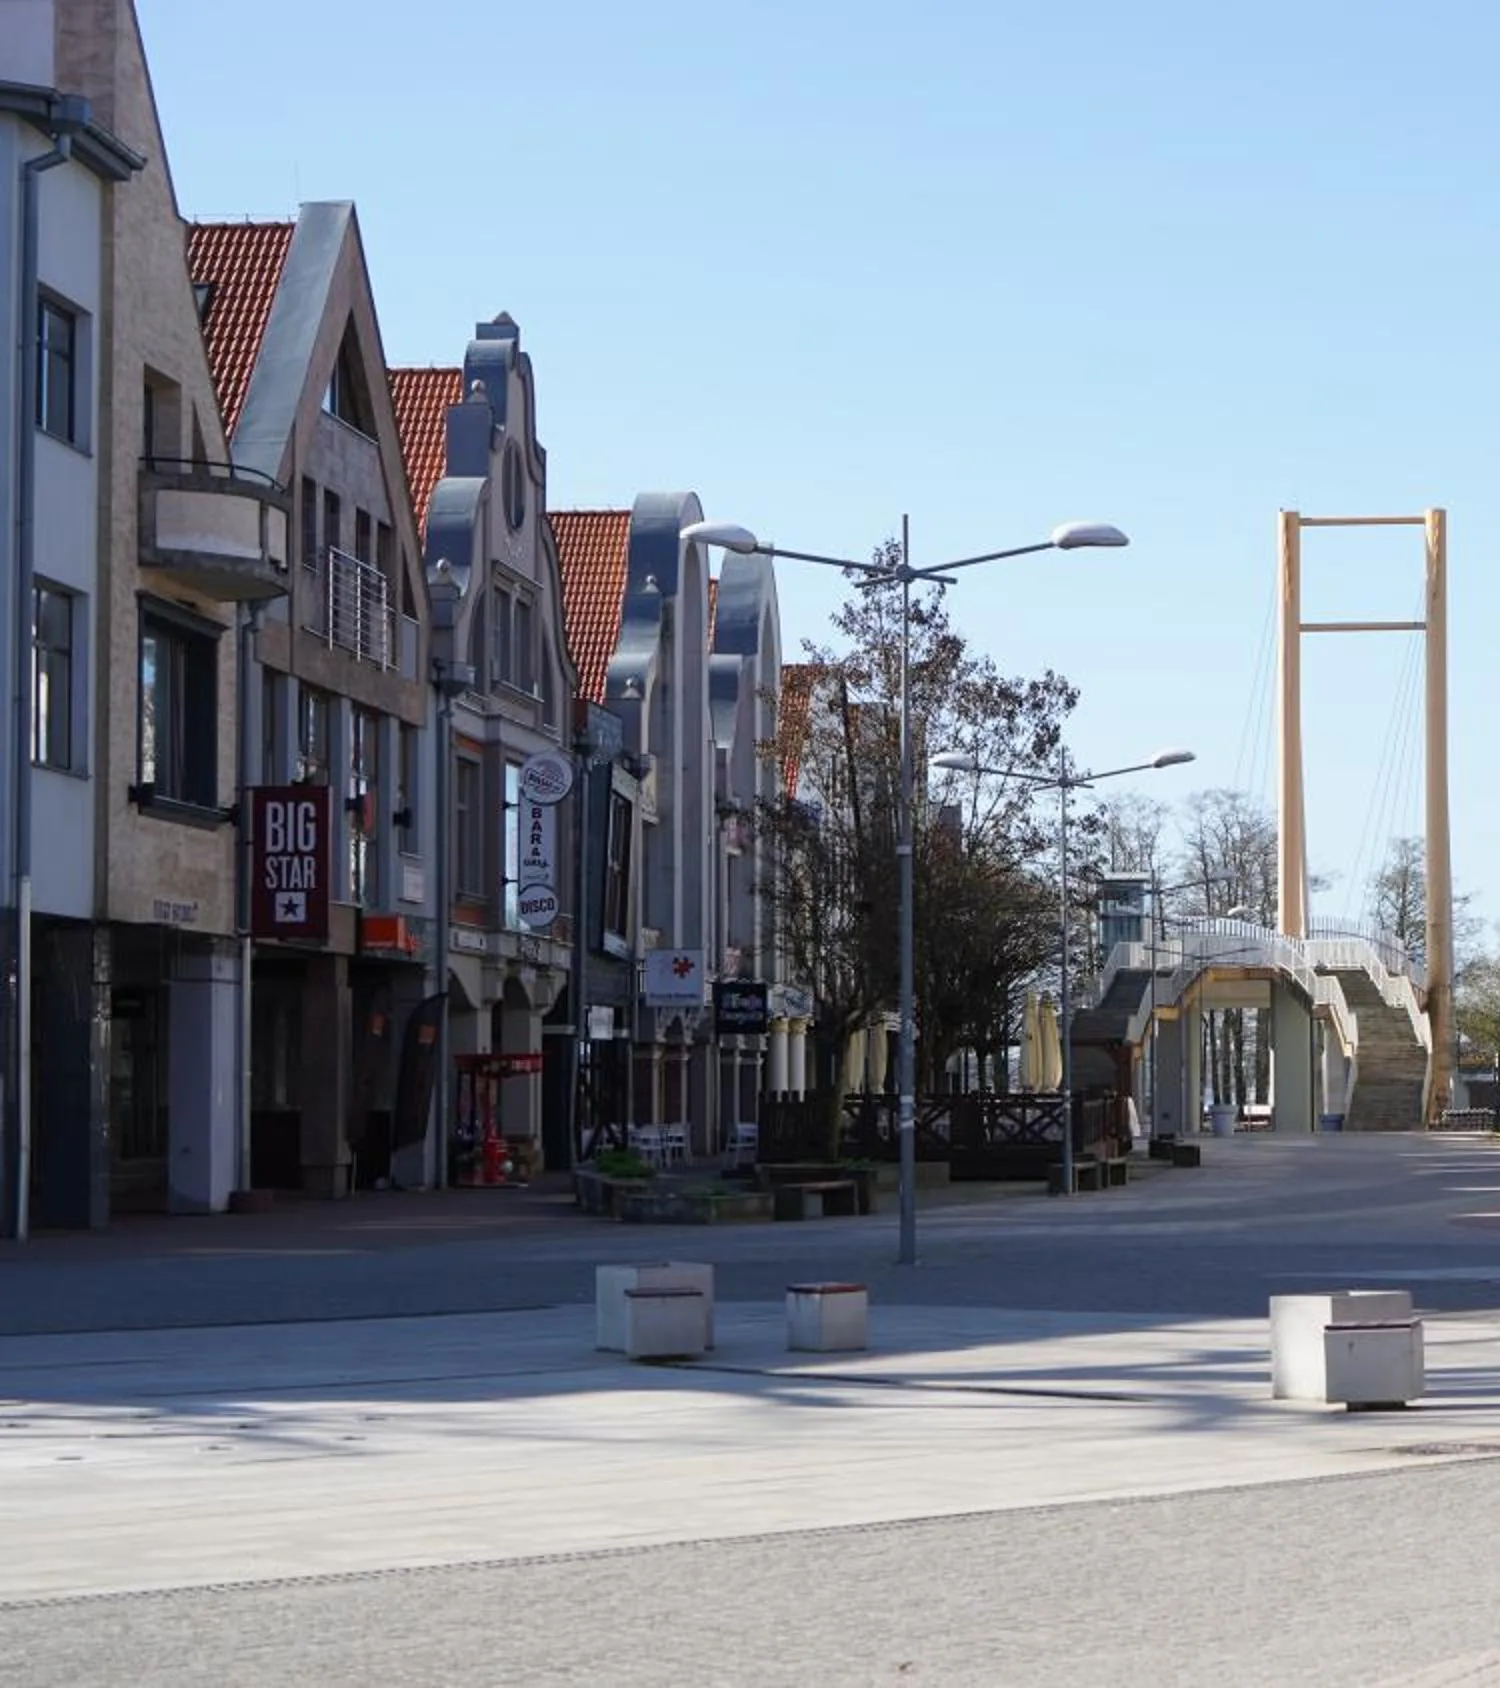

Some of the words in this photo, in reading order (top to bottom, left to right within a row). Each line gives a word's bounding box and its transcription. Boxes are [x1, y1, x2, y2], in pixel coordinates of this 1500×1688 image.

[266, 802, 316, 853] BIG
[531, 807, 542, 844] BAR
[265, 855, 316, 889] STAR
[521, 898, 554, 914] DISCO
